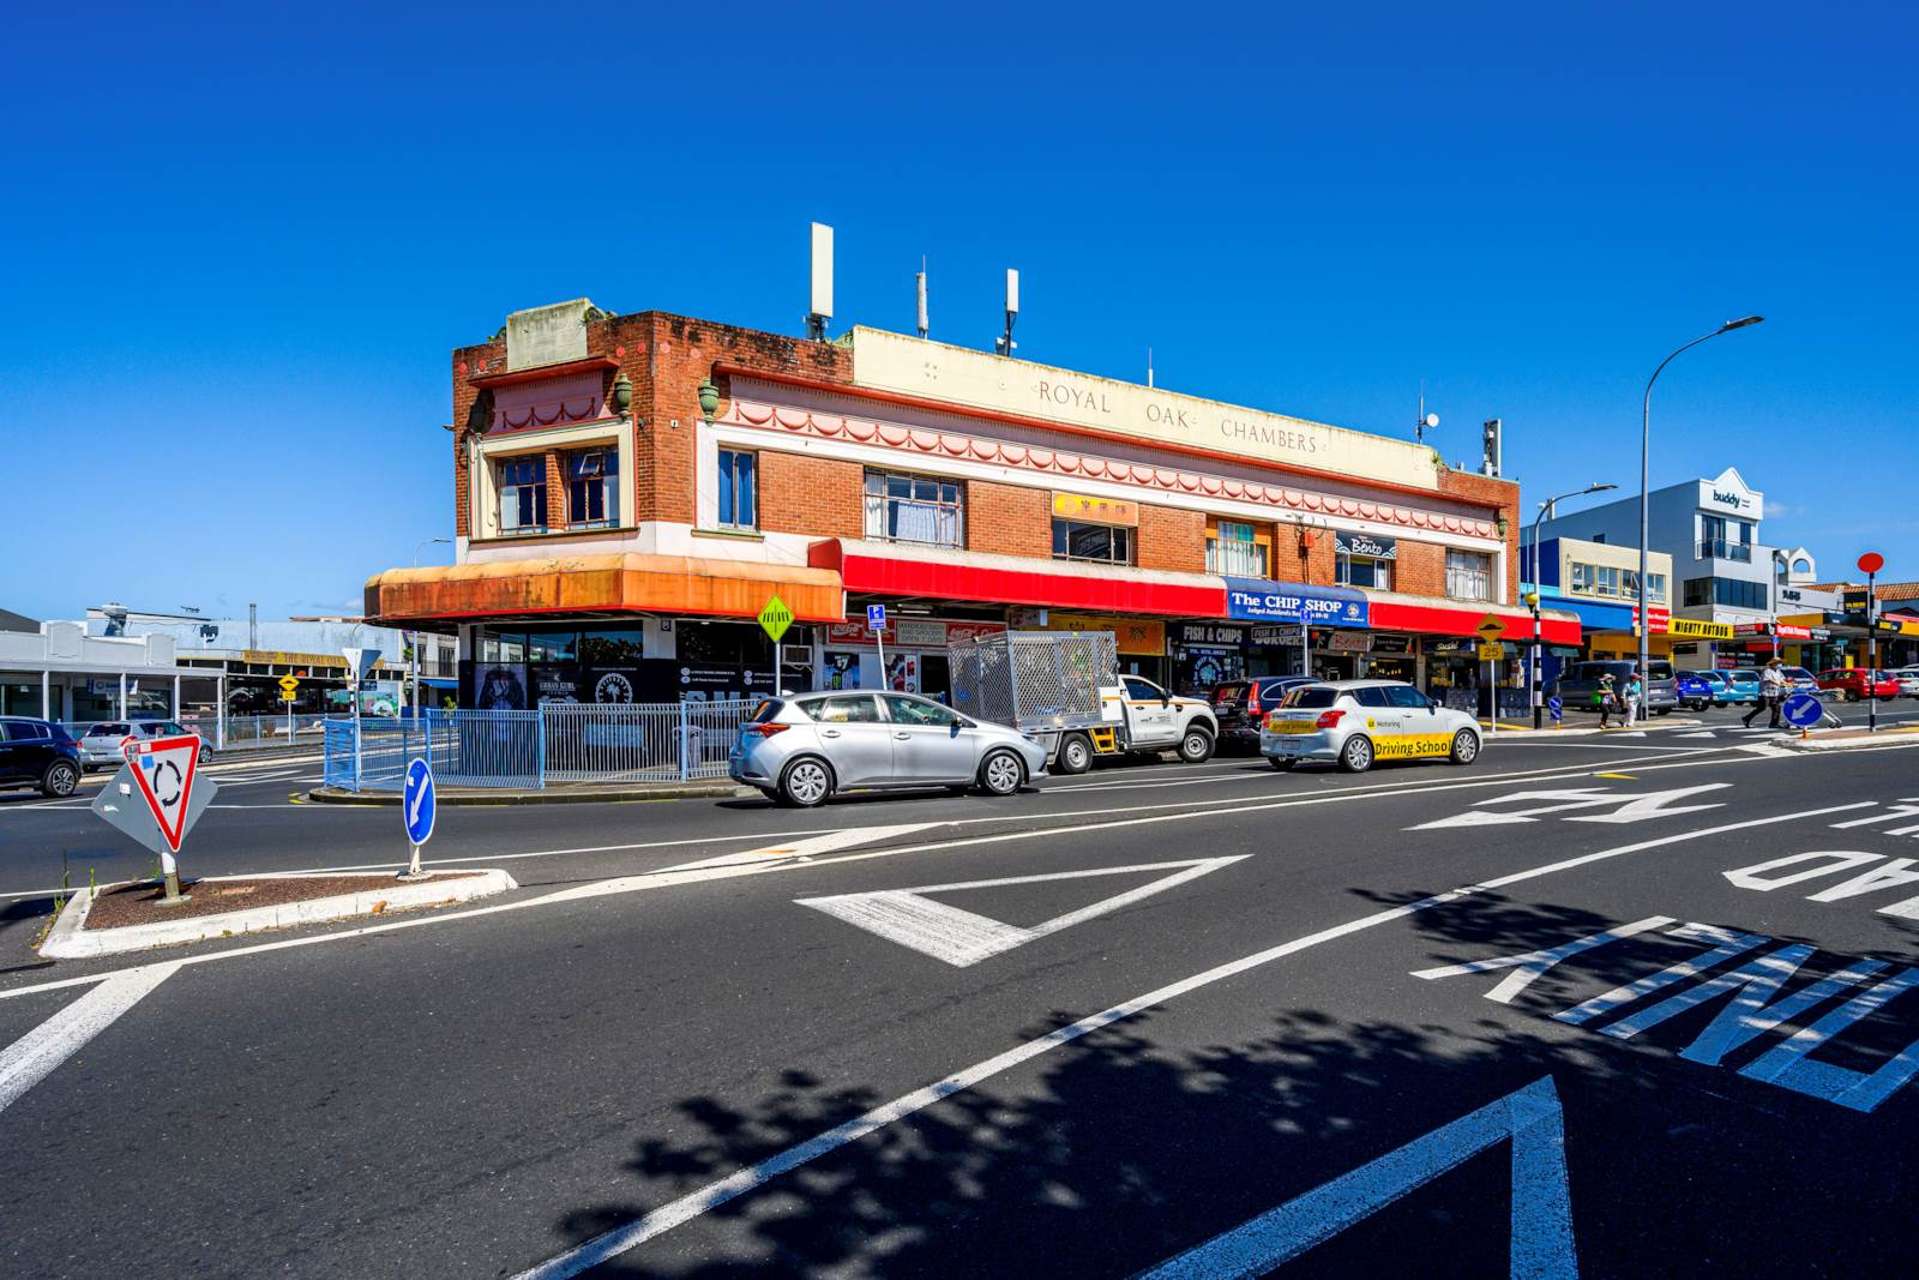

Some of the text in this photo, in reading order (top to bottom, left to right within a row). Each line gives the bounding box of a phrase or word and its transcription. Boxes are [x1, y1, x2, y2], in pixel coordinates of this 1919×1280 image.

[1039, 380, 1316, 453] ROYAL OAK CHAMBERS
[1713, 489, 1740, 508] buddy
[1351, 538, 1382, 554] Bento
[1232, 592, 1342, 612] The CHIP SHOP
[1184, 626, 1242, 642] FISH & CHIPS
[1483, 646, 1499, 657] 25
[1377, 720, 1401, 729] Motoring
[1375, 736, 1451, 757] Driving School
